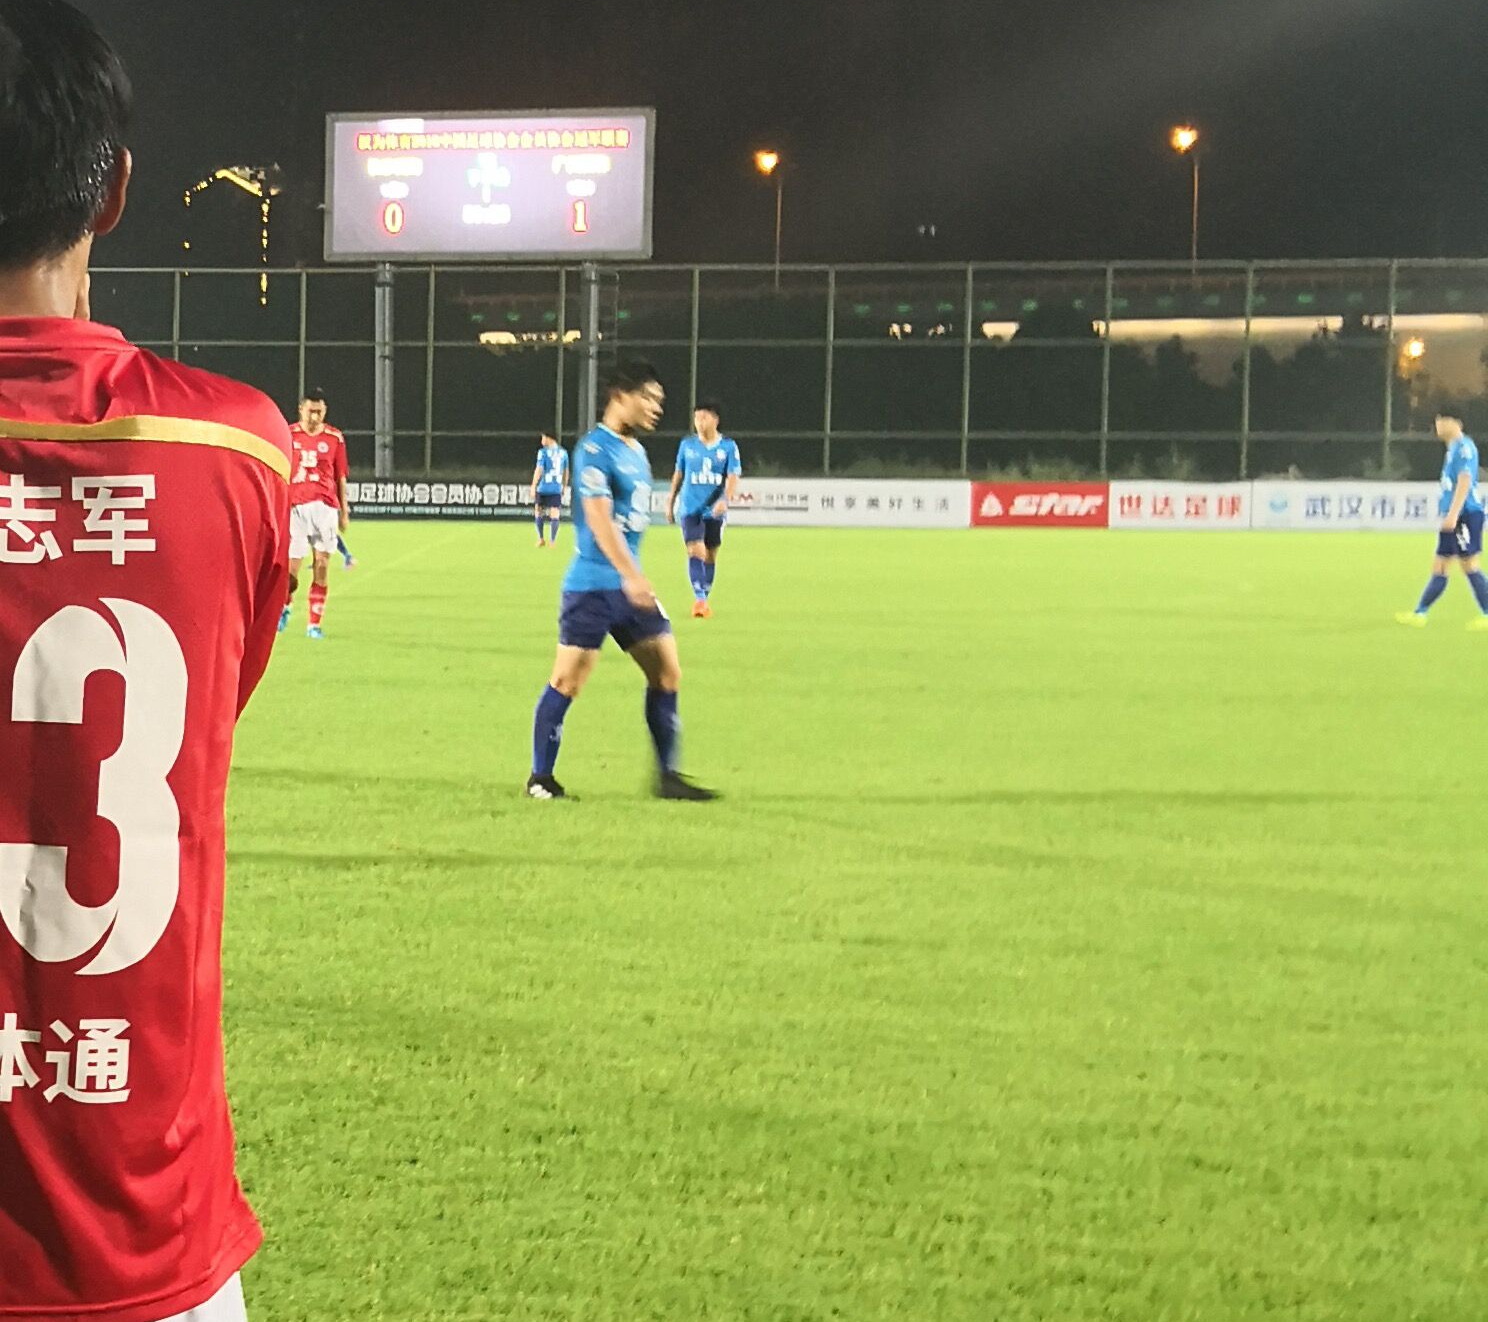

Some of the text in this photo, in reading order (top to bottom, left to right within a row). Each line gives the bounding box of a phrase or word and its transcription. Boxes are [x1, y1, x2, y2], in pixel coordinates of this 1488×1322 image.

[383, 200, 588, 233] 0 1
[346, 482, 571, 505] 国足球协会会员协会冠军
[1119, 494, 1242, 518] 世达足球
[1305, 495, 1443, 520] 武汉市足
